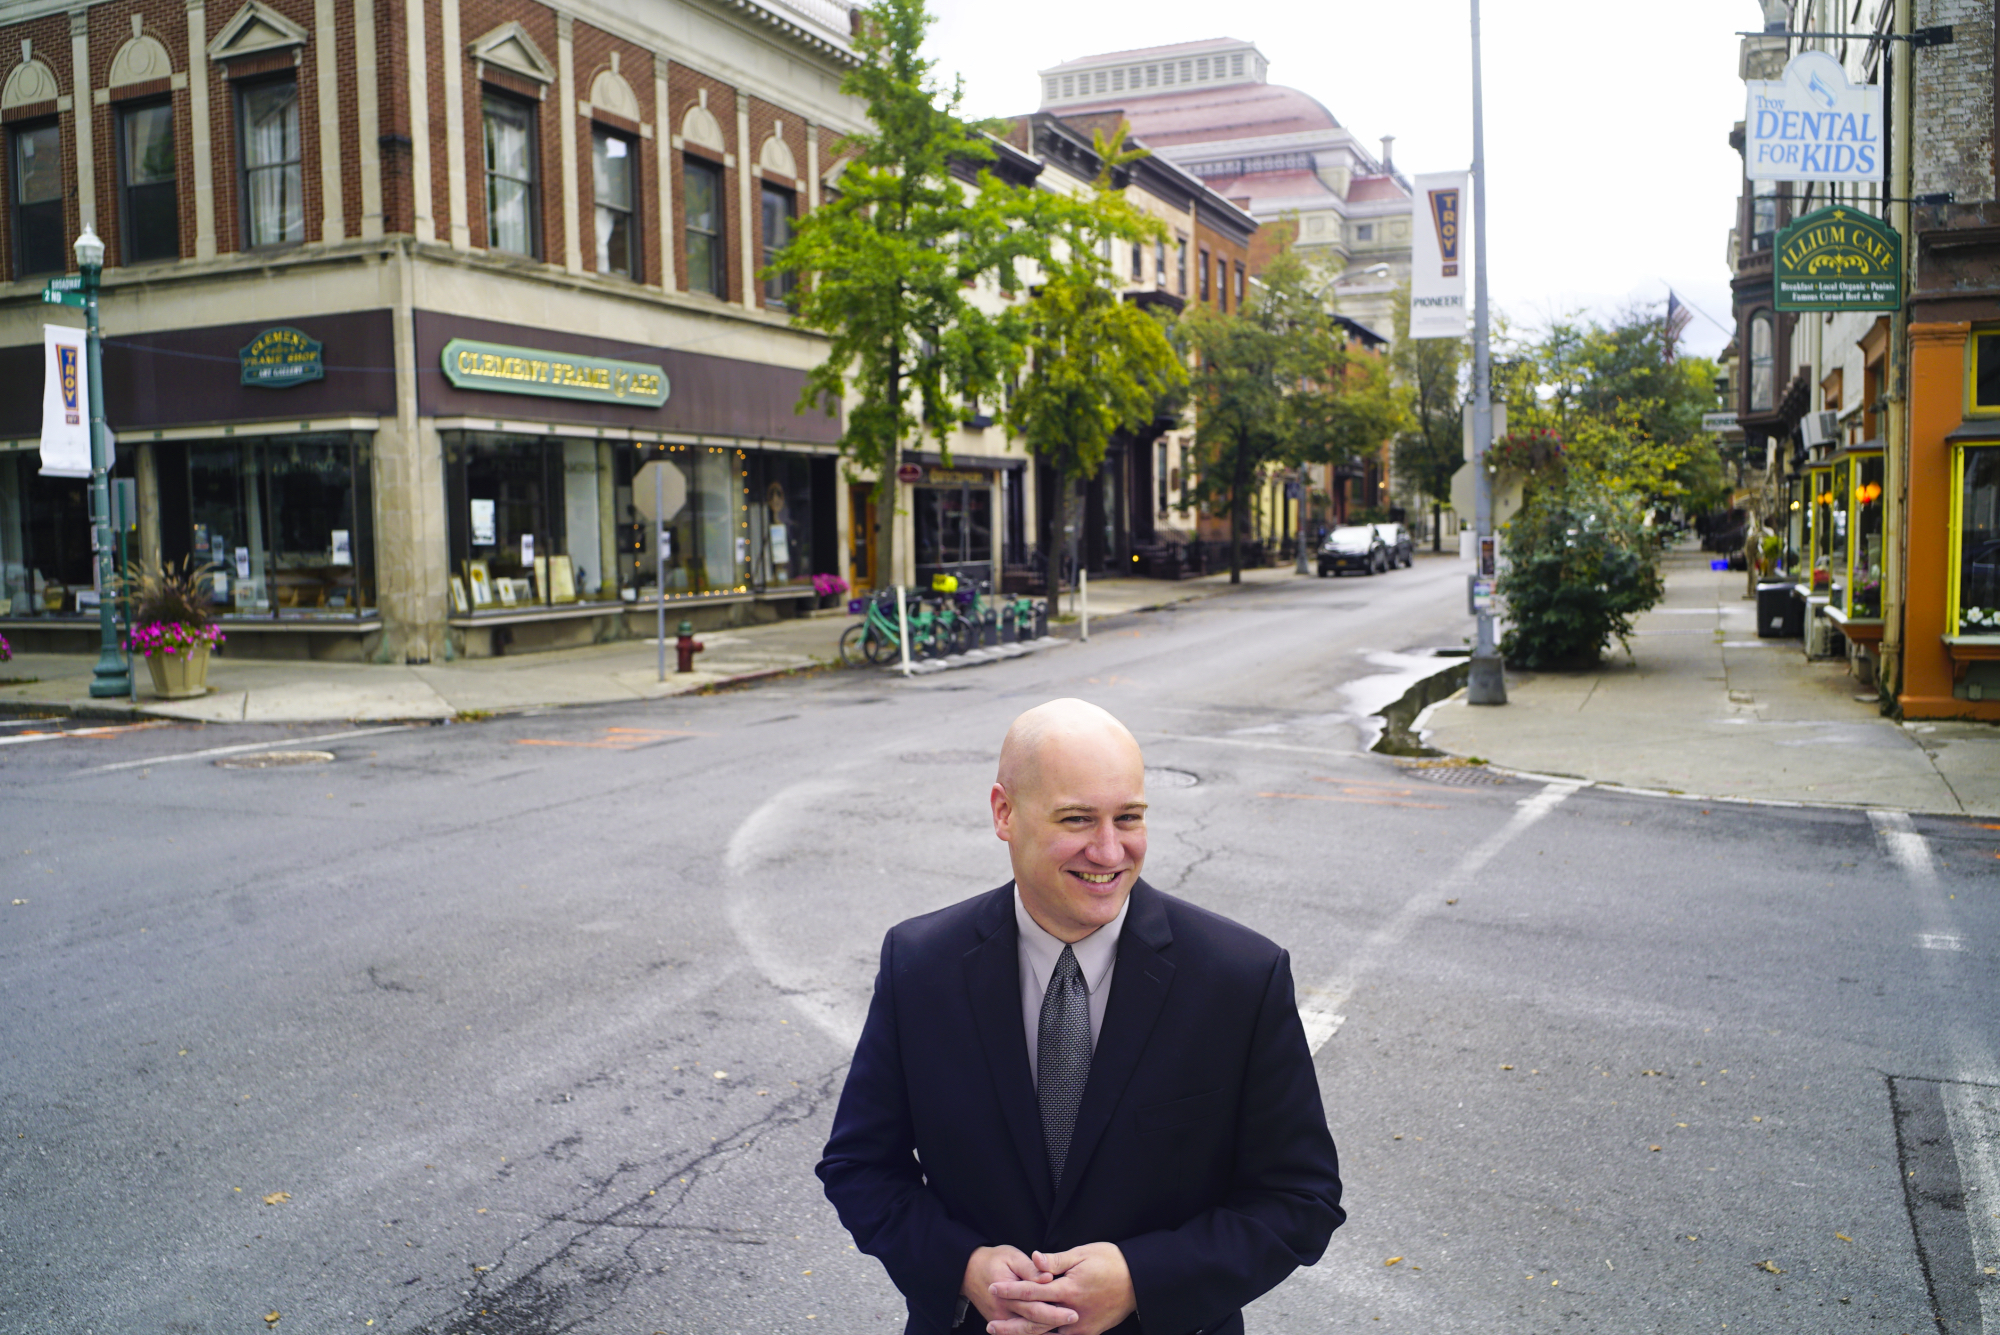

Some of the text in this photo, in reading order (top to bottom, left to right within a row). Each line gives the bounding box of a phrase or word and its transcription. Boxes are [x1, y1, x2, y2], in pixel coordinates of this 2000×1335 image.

[1755, 95, 1785, 112] Troy
[1755, 110, 1877, 142] DENTAL
[1758, 143, 1875, 174] FOR KIDS
[1442, 196, 1455, 251] TROY
[1782, 226, 1894, 271] ILLIUM CAFE
[51, 278, 81, 290] BROADWAY
[1781, 281, 1814, 292] Breakfast
[1819, 281, 1837, 291] Local
[1839, 281, 1865, 292] Organic
[244, 351, 317, 367] FRAME SHOP
[251, 331, 308, 356] CLEMENT
[65, 351, 75, 402] TROY
[458, 351, 549, 382] CLEMENT
[552, 363, 611, 390] FRAME
[629, 374, 660, 395] ART
